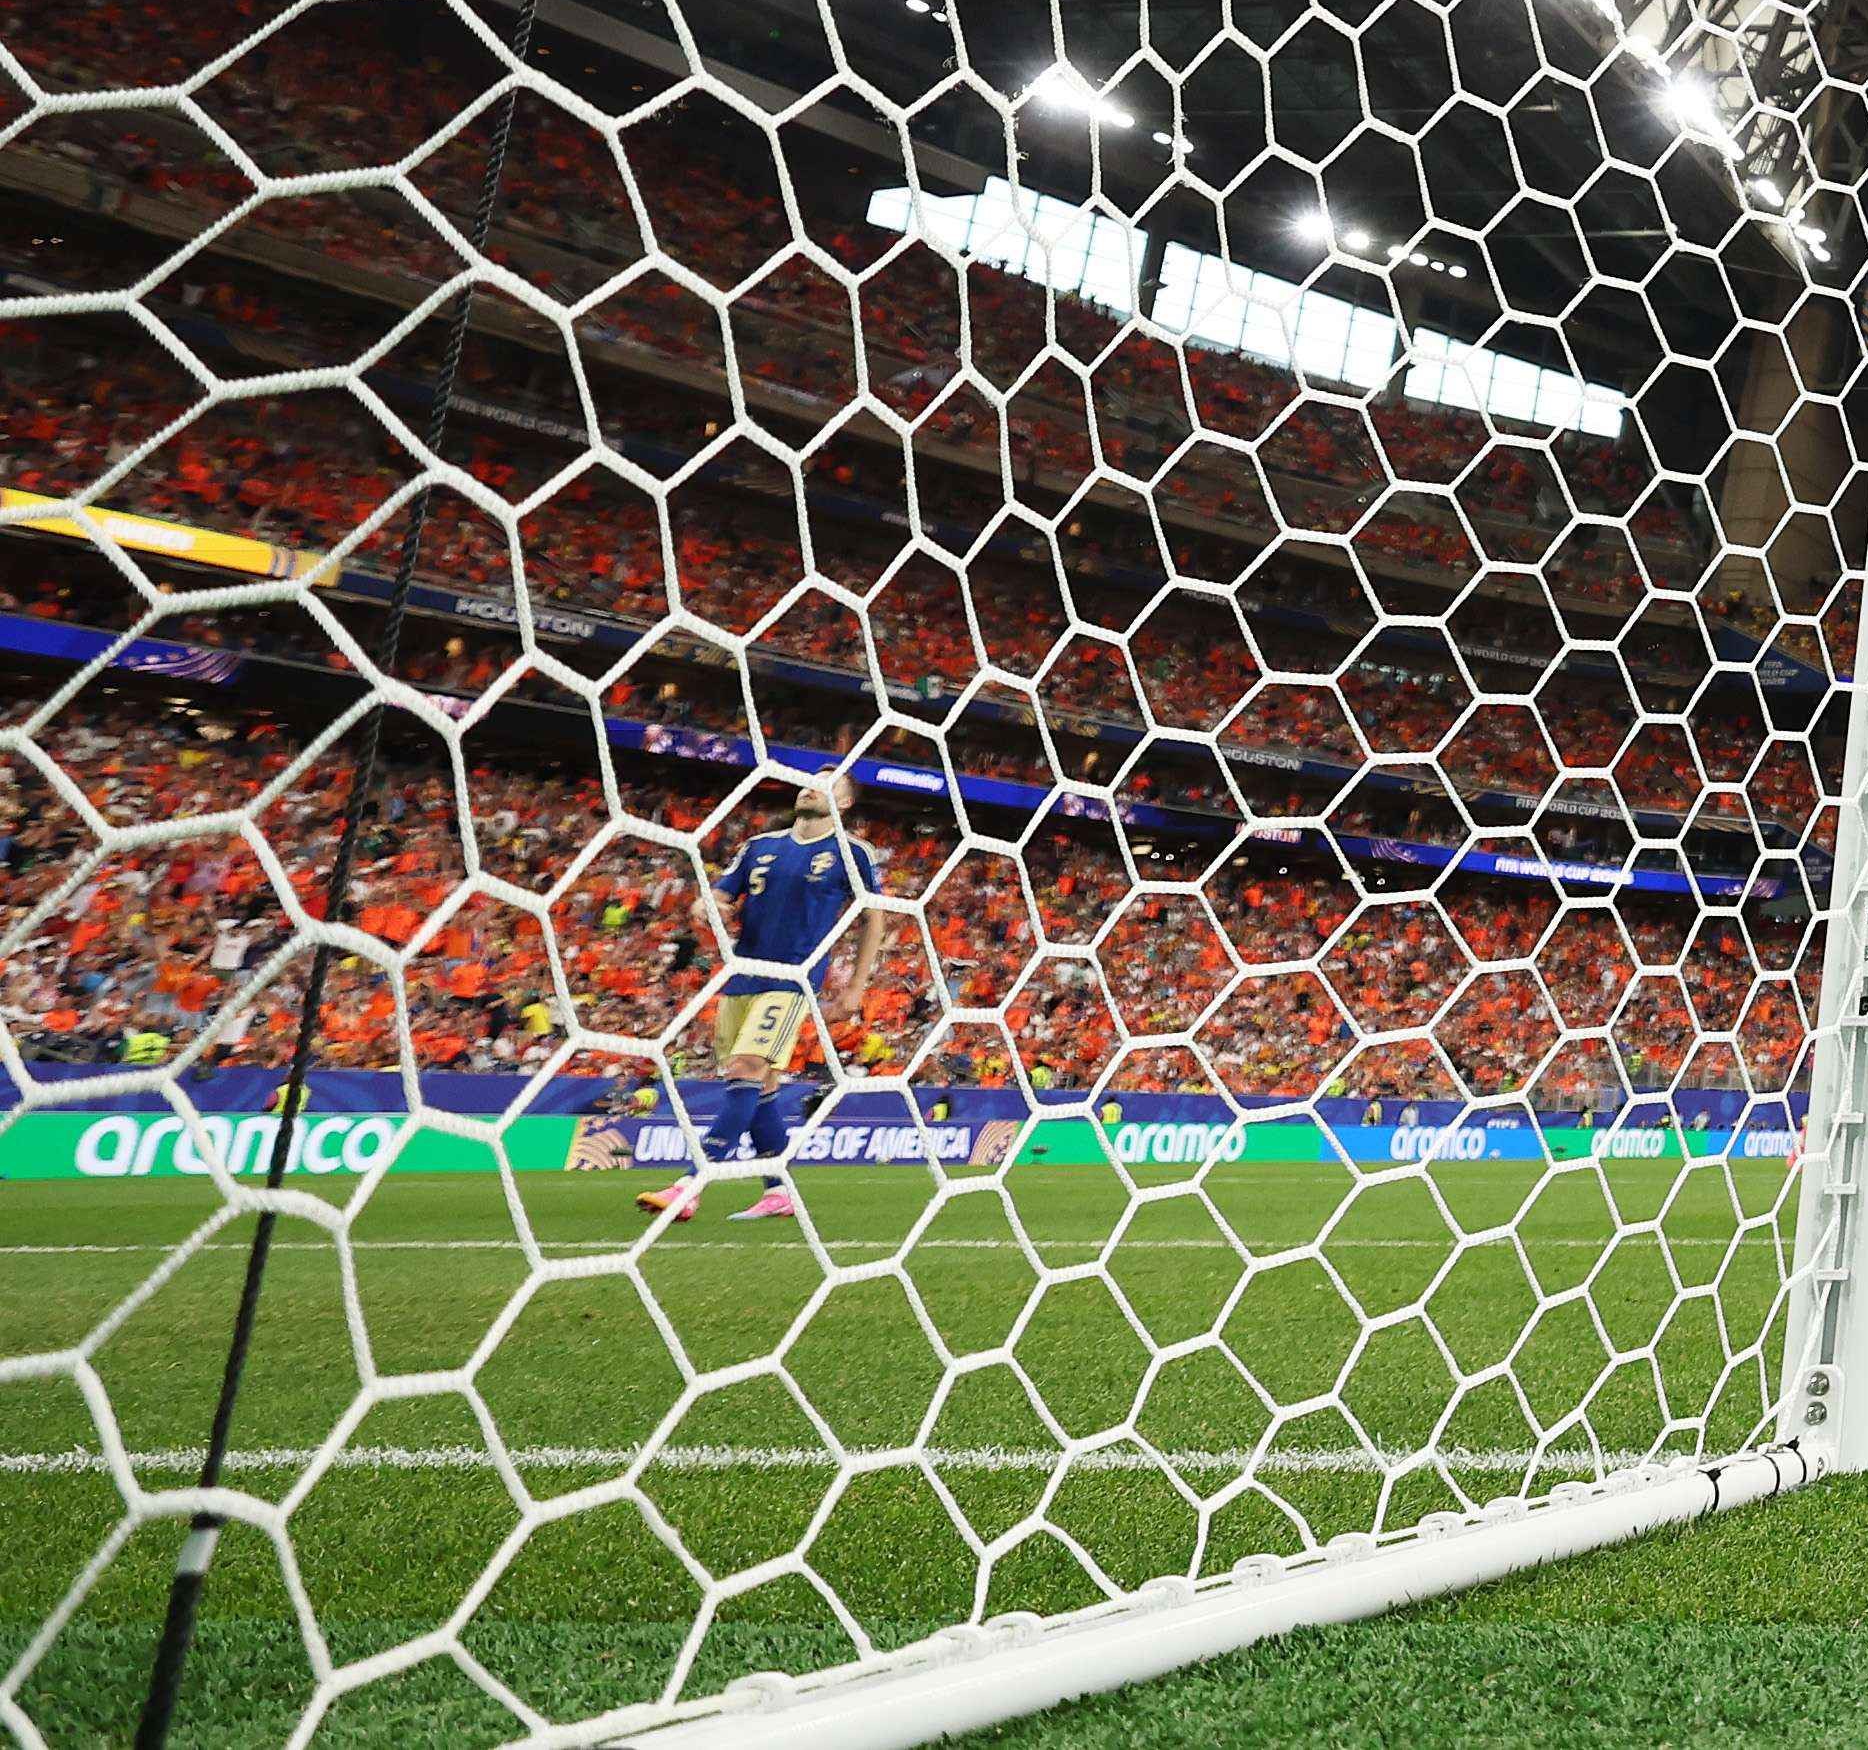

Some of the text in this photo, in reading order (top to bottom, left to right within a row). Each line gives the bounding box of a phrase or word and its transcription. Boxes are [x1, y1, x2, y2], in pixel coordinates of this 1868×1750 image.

[454, 598, 596, 638] HOUTON
[748, 866, 771, 896] 5
[760, 1005, 782, 1031] 5
